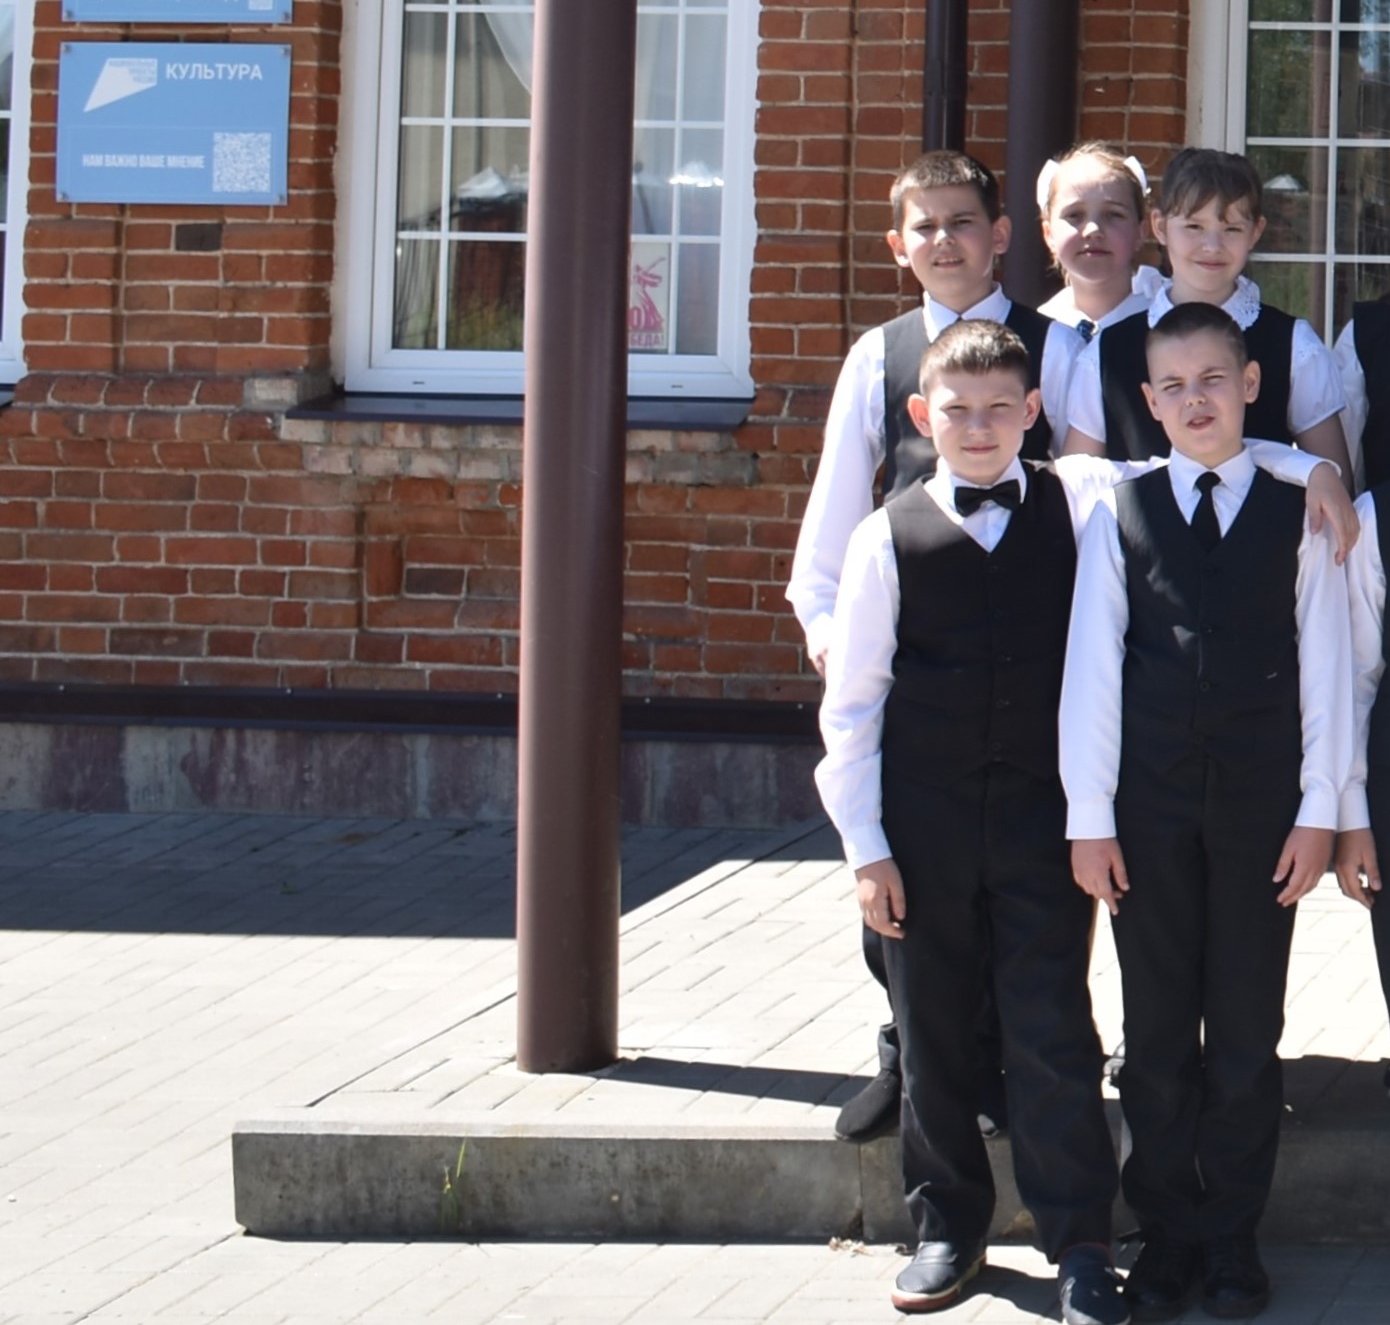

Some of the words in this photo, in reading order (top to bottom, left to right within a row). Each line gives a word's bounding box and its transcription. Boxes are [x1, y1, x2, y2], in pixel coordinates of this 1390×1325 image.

[165, 63, 263, 80] КУЛЬТУРА
[105, 155, 137, 168] ВАЖНО
[139, 155, 165, 168] ВАШЕ
[167, 155, 205, 169] МНЕНИЕ
